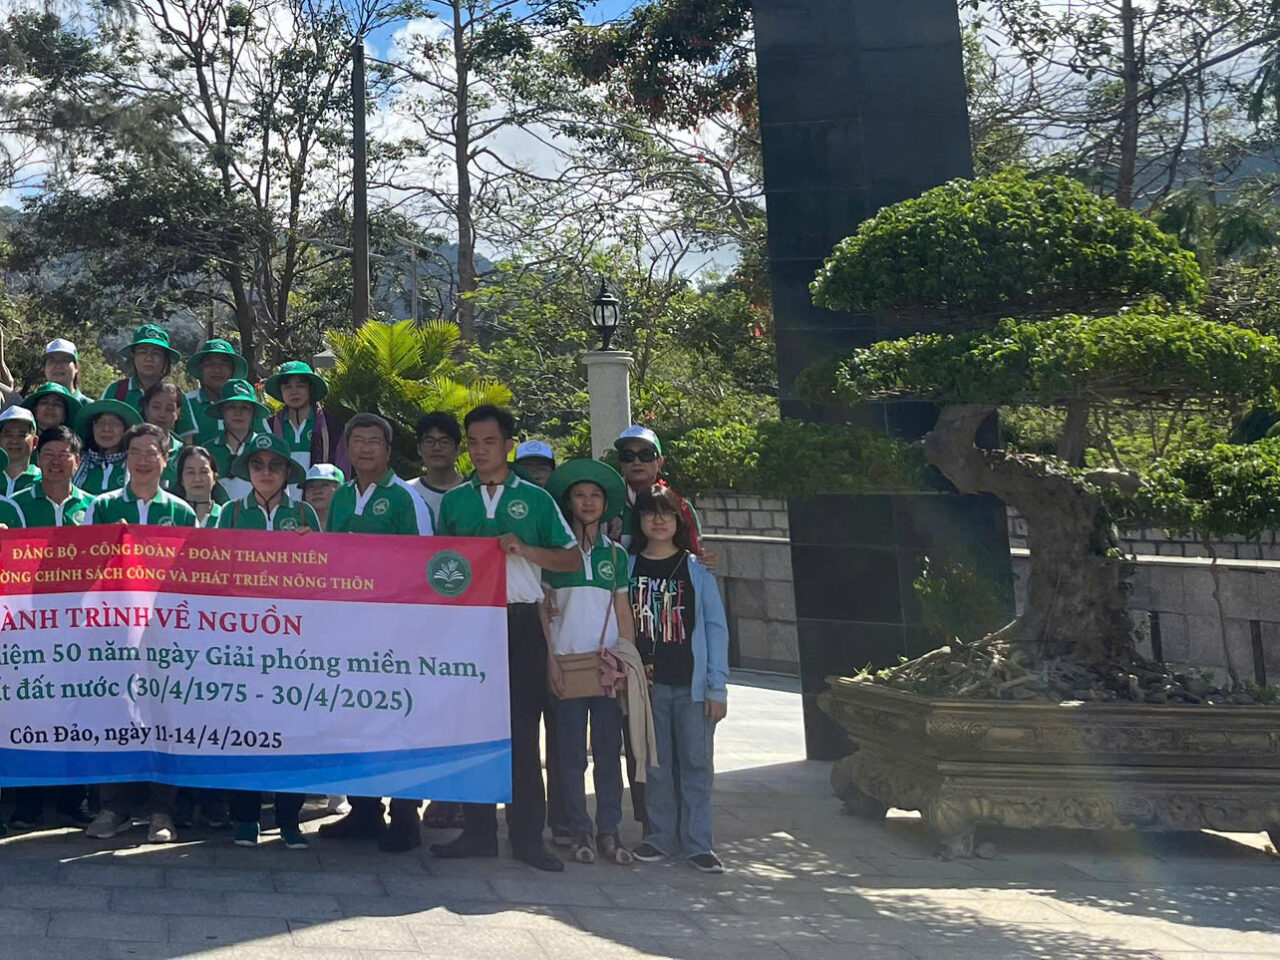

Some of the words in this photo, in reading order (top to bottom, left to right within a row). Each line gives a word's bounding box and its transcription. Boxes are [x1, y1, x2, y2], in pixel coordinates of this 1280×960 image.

[12, 546, 53, 560] ĐẢNG
[57, 544, 77, 560] BỘ
[90, 542, 131, 556] CÔNG
[134, 544, 176, 557] ĐOÀN
[189, 546, 231, 561] ĐOÀN
[235, 549, 288, 564] THANH
[292, 549, 328, 565] NIÊN
[35, 567, 82, 582] CHÍNH
[86, 566, 123, 580] SÁCH
[127, 564, 166, 580] CÔNG
[170, 568, 187, 582] VÀ
[191, 570, 229, 585] PHÁT
[233, 569, 279, 587] TRIỂN
[283, 573, 327, 589] NÔNG
[330, 575, 374, 590] THÔN
[65, 601, 150, 629] TRÌNH
[155, 600, 190, 629] VỀ
[198, 605, 302, 636] NGUỒN
[52, 643, 82, 663] 50
[88, 640, 141, 662] năm
[146, 642, 199, 670] ngày
[205, 644, 255, 667] Giải
[261, 647, 341, 678] phóng
[347, 649, 411, 675] miền
[418, 656, 486, 683] Nam,
[16, 674, 56, 700] đất
[61, 676, 120, 698] nước
[126, 673, 247, 705] (30/4/1975
[271, 683, 413, 717] 30/4/2025)
[10, 725, 48, 744] Côn
[53, 723, 99, 745] Đảo,
[104, 721, 152, 745] ngày
